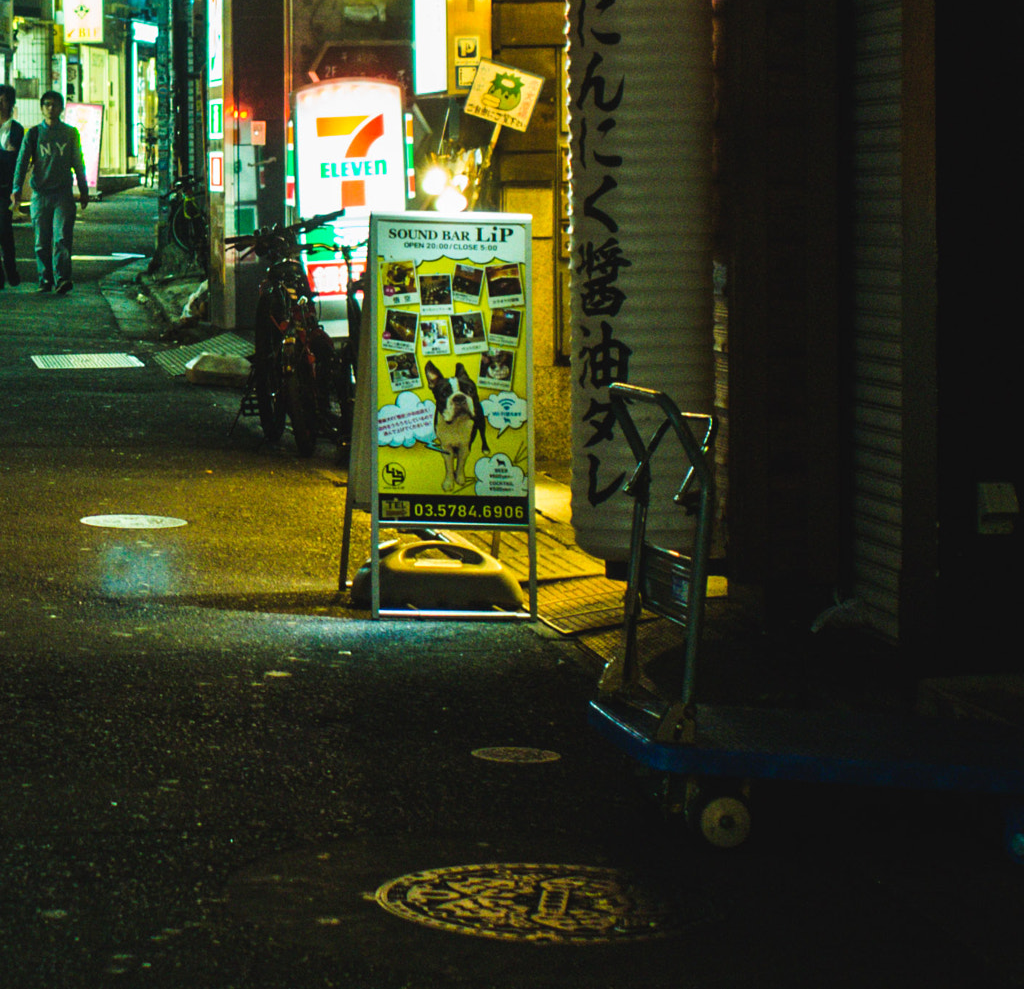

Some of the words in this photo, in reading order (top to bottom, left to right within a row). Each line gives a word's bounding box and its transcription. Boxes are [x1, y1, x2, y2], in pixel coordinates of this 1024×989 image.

[388, 228, 438, 241] SOUND
[442, 231, 470, 241] BAR
[476, 226, 514, 243] LiP
[413, 502, 524, 519] 03.5784.6906
